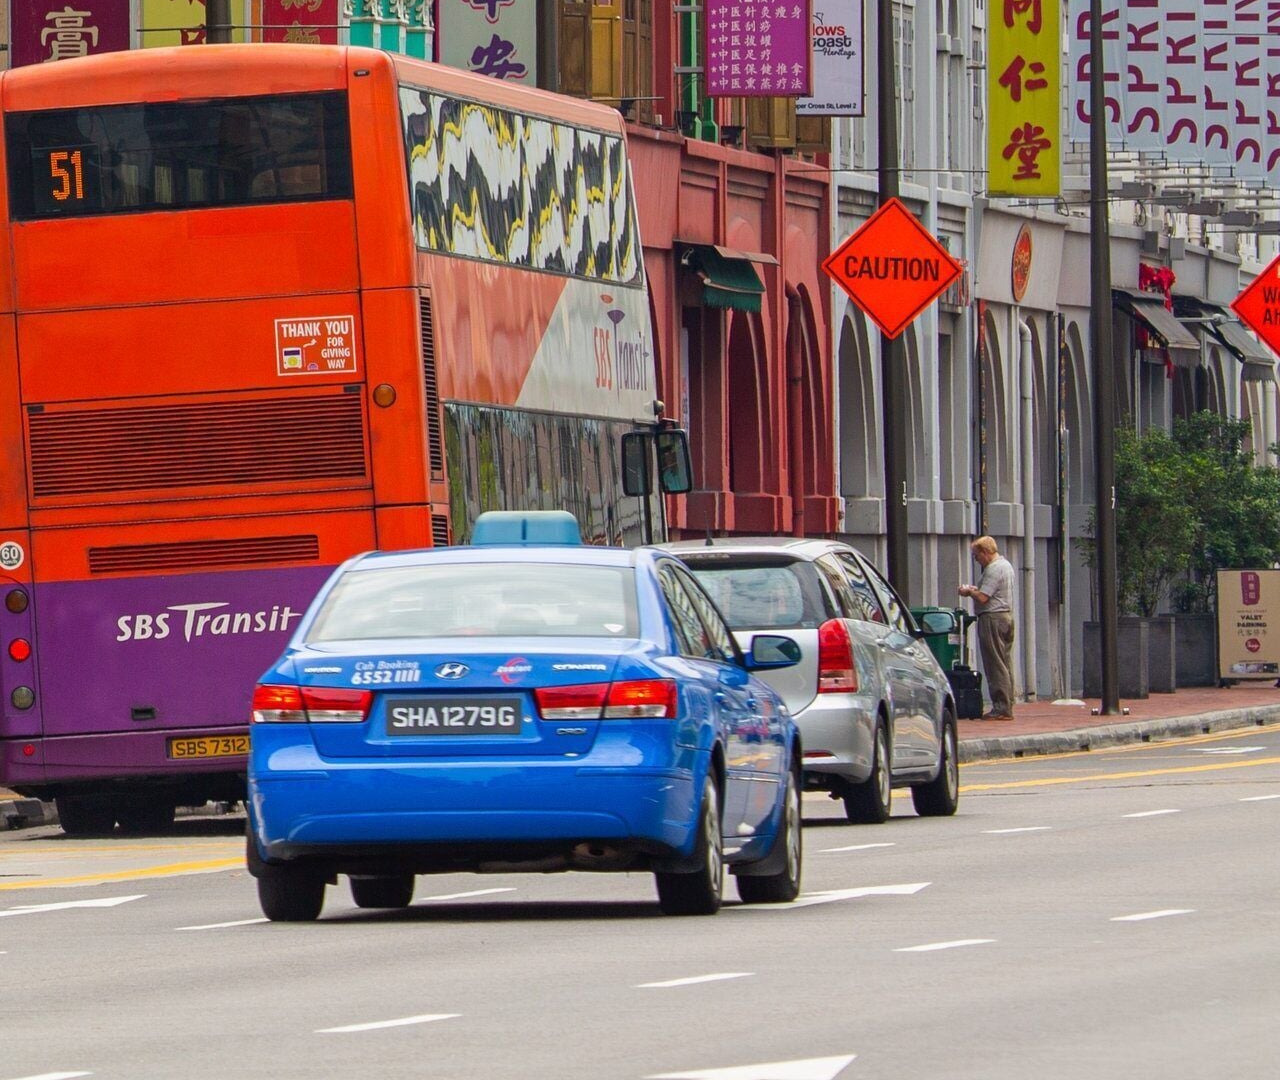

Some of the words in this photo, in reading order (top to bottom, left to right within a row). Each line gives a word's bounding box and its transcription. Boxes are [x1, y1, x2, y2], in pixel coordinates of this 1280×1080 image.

[719, 5, 802, 19] 中医针灸瘦身
[719, 20, 771, 33] 中医刮痧
[813, 23, 845, 36] lows
[719, 34, 772, 47] 中医拔罐
[719, 49, 771, 62] 中医足疗
[823, 48, 856, 60] Heritage
[719, 63, 803, 77] 中医保健推拿
[51, 151, 84, 200] 51
[844, 255, 940, 283] CAUTION
[281, 323, 321, 338] THANK
[325, 321, 348, 335] YOU
[327, 337, 344, 347] FOR
[321, 348, 350, 358] GIVING
[593, 326, 612, 391] SBS
[327, 359, 345, 369] WAY
[2, 547, 18, 560] 60
[116, 613, 169, 642] SBS
[167, 602, 302, 642] Transit
[355, 661, 374, 670] Cab
[378, 660, 419, 671] Booking
[351, 671, 392, 685] 6552
[394, 670, 420, 682] 1111
[392, 706, 515, 727] SHA1279G
[175, 741, 207, 756] SBS
[210, 738, 246, 754] 7312
